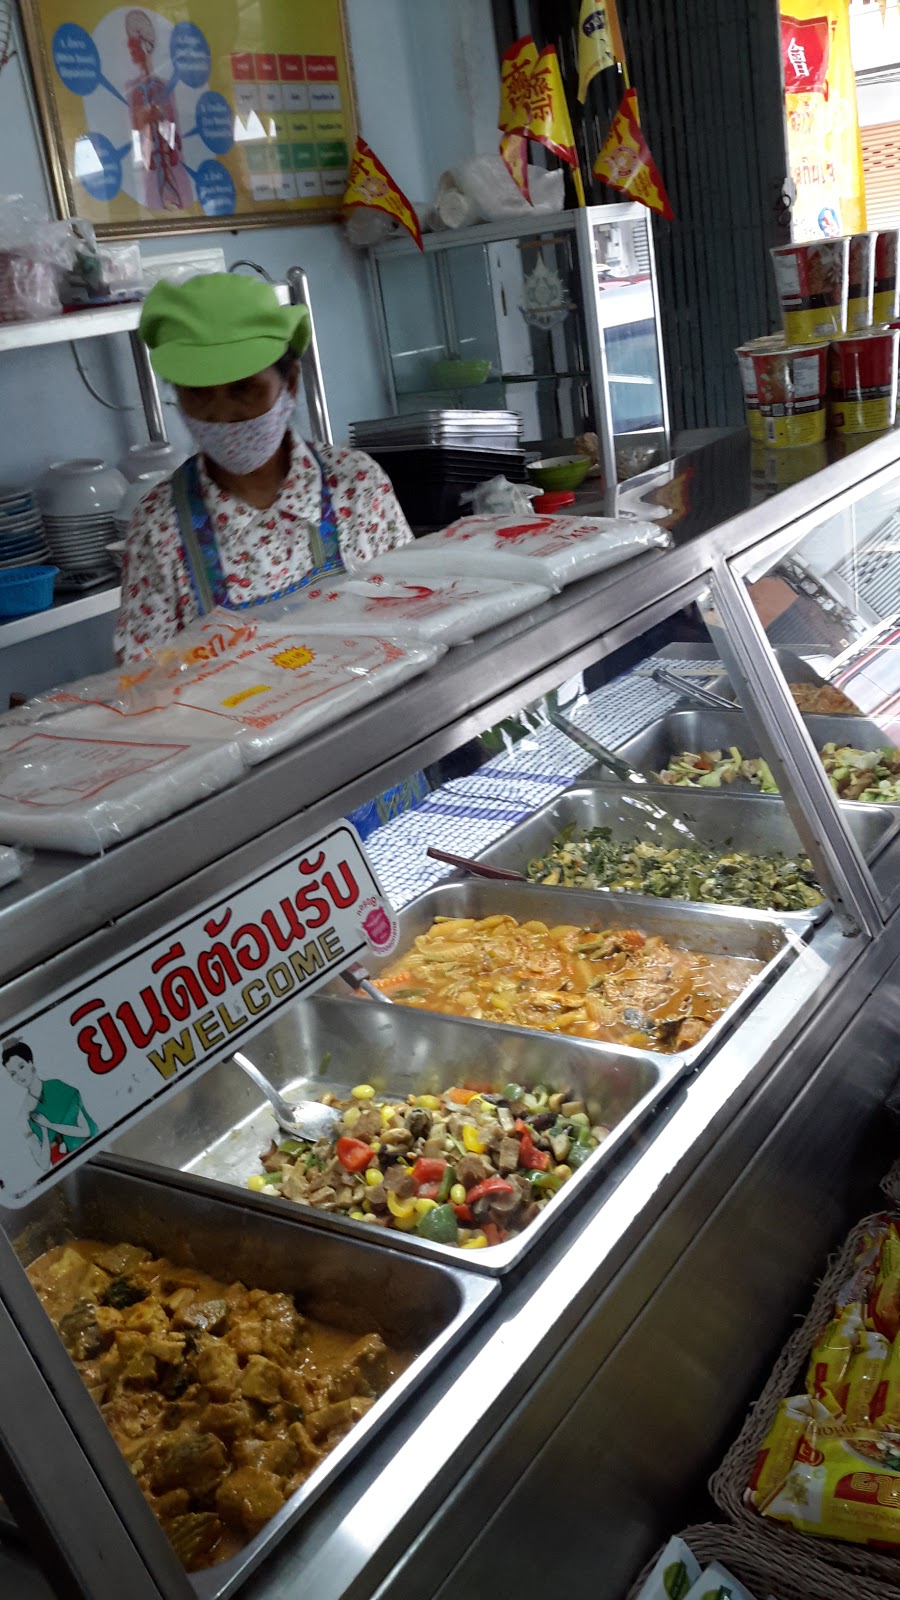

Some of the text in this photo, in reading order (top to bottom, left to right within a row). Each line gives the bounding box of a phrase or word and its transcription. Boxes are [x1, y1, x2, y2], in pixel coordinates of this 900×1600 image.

[70, 851, 360, 1075] ยินดีต้อนรับ
[147, 926, 345, 1081] WELCOME
